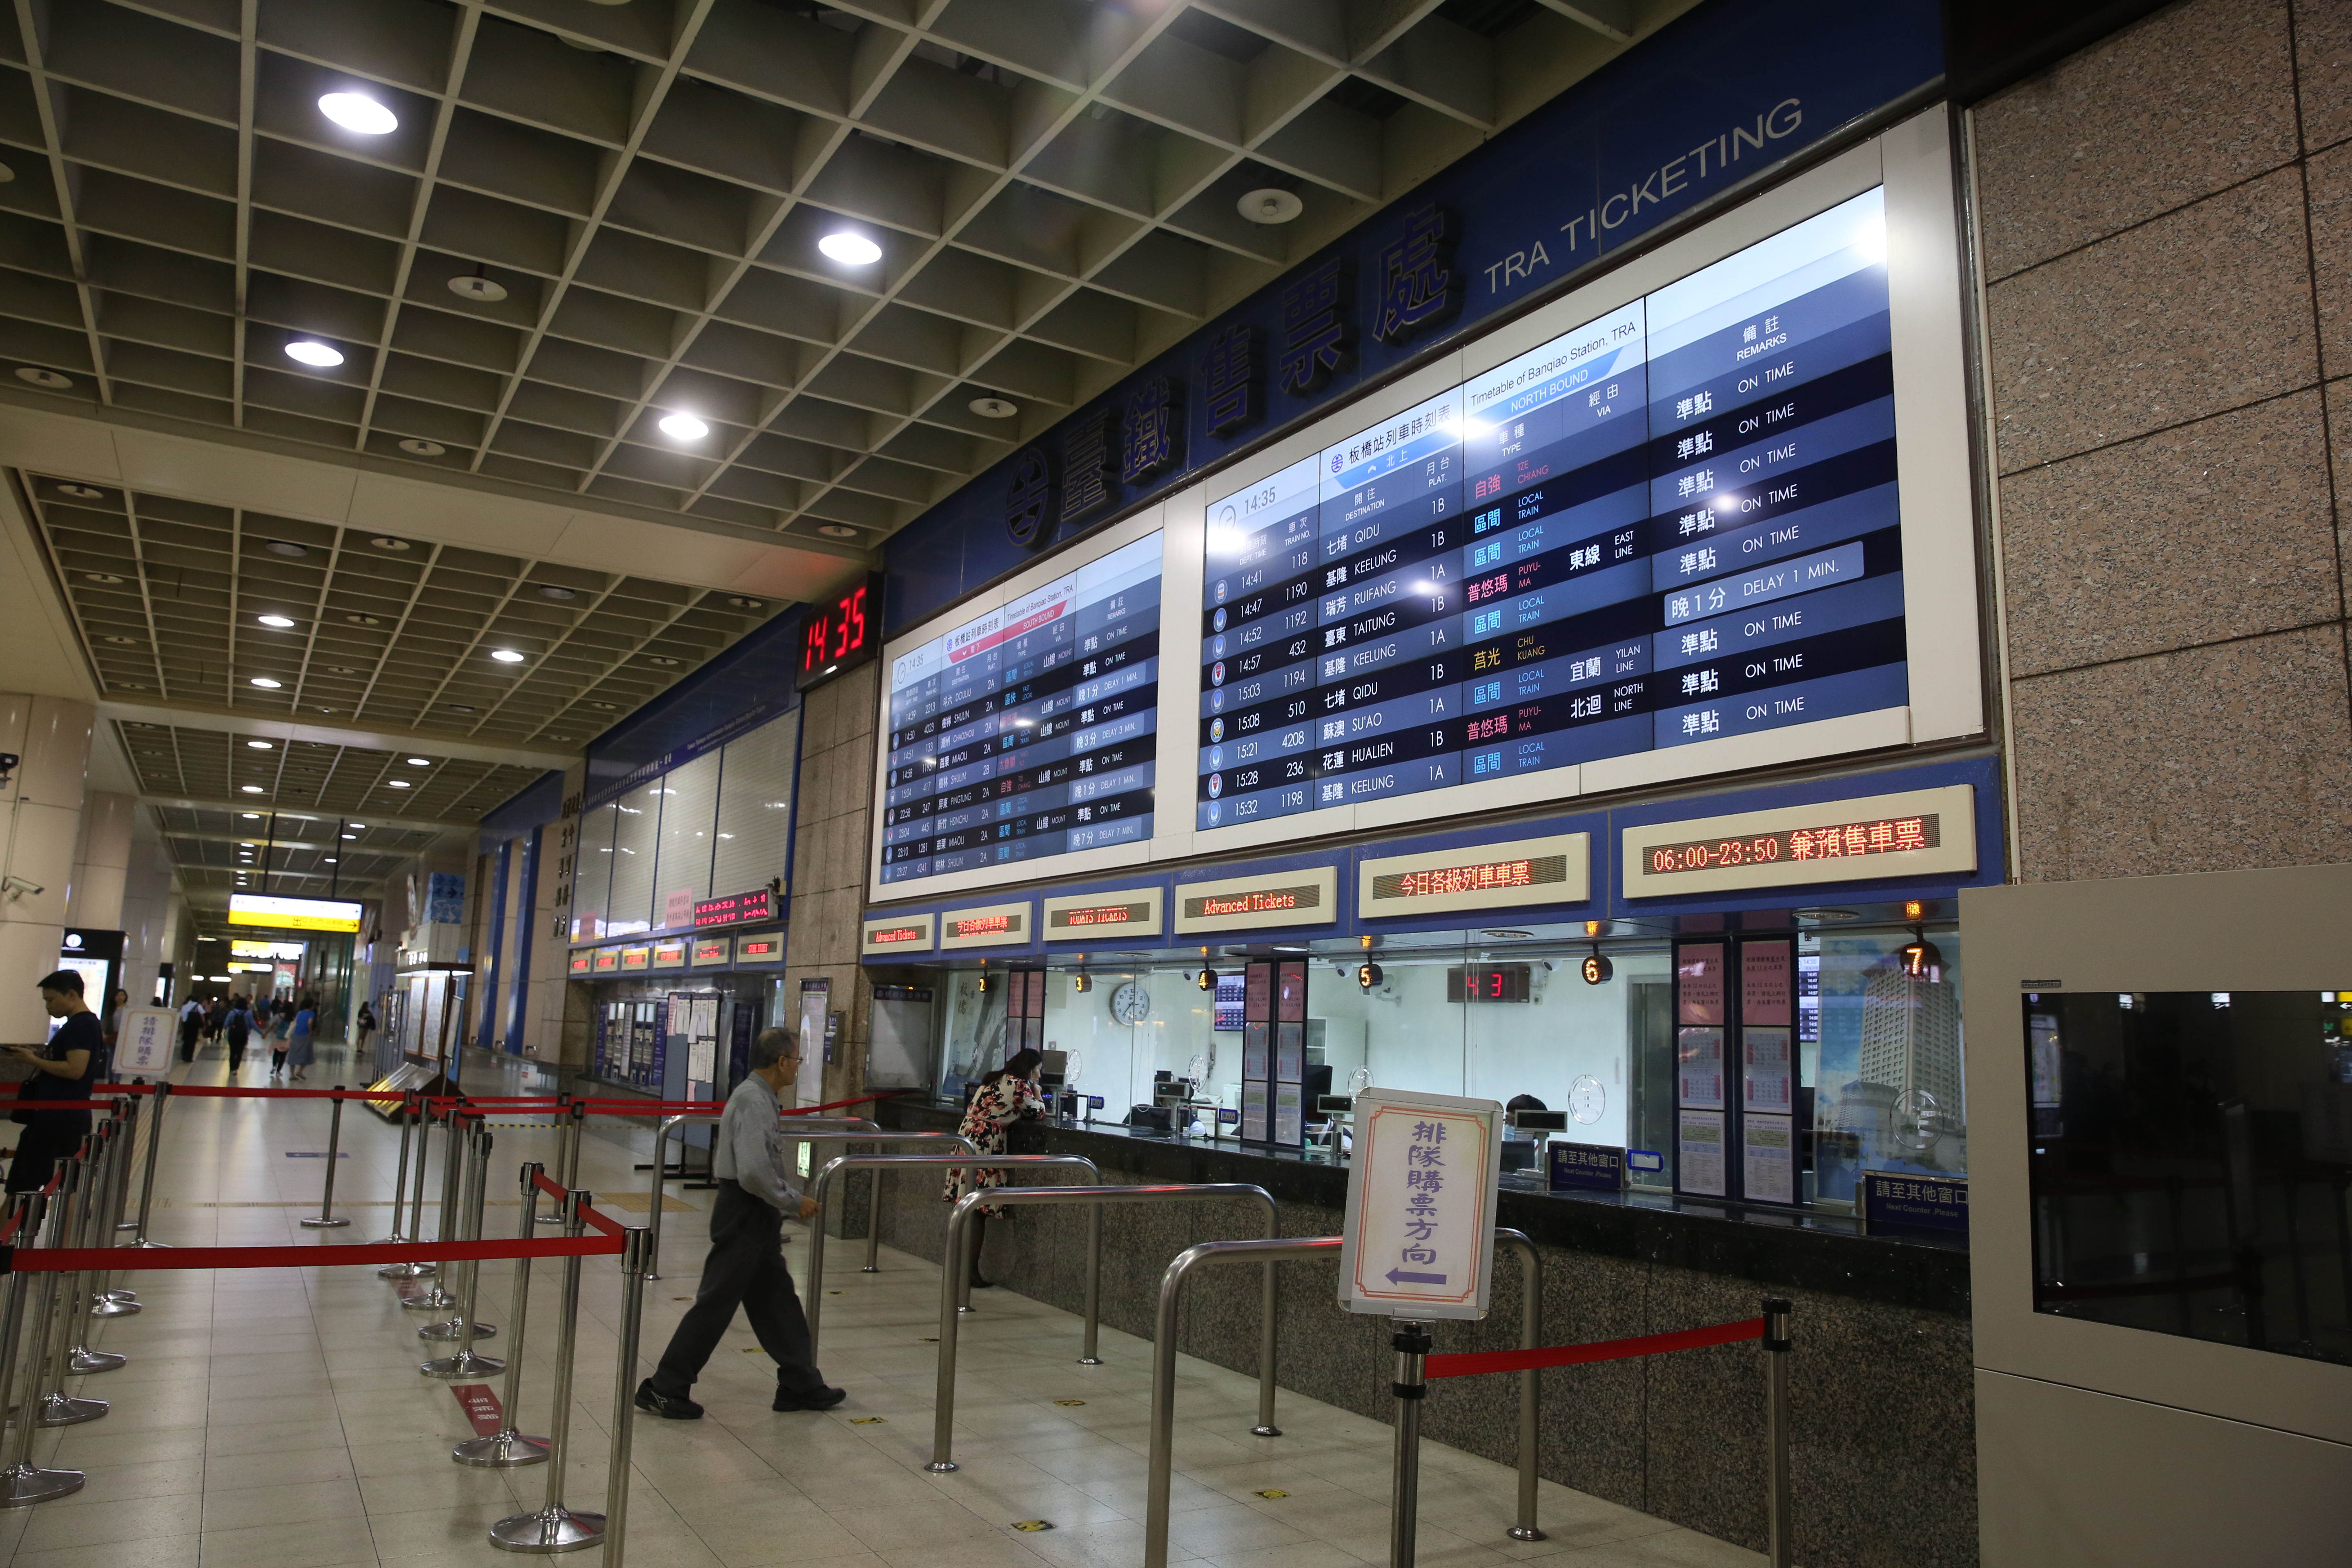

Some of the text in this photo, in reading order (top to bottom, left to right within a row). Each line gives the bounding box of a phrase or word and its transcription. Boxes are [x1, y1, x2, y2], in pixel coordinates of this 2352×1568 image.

[1484, 98, 1802, 294] TRA TICKETING
[1737, 333, 1787, 361] REMARKS
[1471, 322, 1636, 406] Timetable of Banqiao Station, TRA
[1511, 369, 1588, 412] NORTH BOUND
[1676, 361, 1794, 420] 準點 ON TIME
[1597, 405, 1611, 417] VIA
[1349, 404, 1450, 464] 板橋站列車時刻表
[1502, 442, 1521, 457] TYPE
[1518, 460, 1528, 471] TZE
[1518, 465, 1549, 483] CHIANG
[1429, 474, 1447, 487] PLAT.
[1476, 474, 1501, 498] 自強
[1245, 486, 1276, 514] 14:35
[1432, 497, 1445, 514] 1B
[1345, 499, 1385, 521] DESTINATION
[1285, 530, 1310, 546] TRAIN NO.
[1326, 523, 1379, 555] 七堵 QIDU
[1615, 531, 1634, 545] EAST
[1240, 548, 1266, 566] DEPT. TIME
[1292, 552, 1307, 568] 118
[1570, 544, 1600, 571] 東線
[1615, 545, 1633, 559] LINE
[1519, 562, 1541, 575] PUYU-
[1242, 570, 1262, 589] 14:41
[1468, 574, 1507, 602] 普悠瑪
[1519, 578, 1531, 588] MA
[1064, 585, 1073, 595] TRA
[1672, 559, 1839, 619] 晚1分 DELAY 1 MIN.
[1432, 596, 1444, 612] 1B
[1023, 610, 1054, 630] SOUTH BOUND
[1107, 608, 1126, 620] REMARKS
[1325, 612, 1395, 648] 臺東 TAITUNG
[1084, 626, 1127, 652] 準點 ON TIME
[1518, 636, 1534, 647] CHU
[1290, 640, 1306, 656] 432
[1517, 646, 1545, 660] KUANG
[1615, 645, 1640, 659] YILAN
[909, 655, 924, 671] 14:35
[1239, 654, 1261, 673] 14:57
[1474, 647, 1500, 670] 莒光
[1616, 660, 1634, 673] LINE
[1431, 664, 1443, 680] 1B
[1519, 669, 1544, 683] LOCAL
[1570, 657, 1601, 682] 宜蘭
[988, 679, 995, 690] 2A
[1474, 682, 1500, 704] 區間
[1519, 683, 1539, 695] TRAIN
[1614, 683, 1643, 697] NORTH
[943, 688, 971, 707] 斗六 DOULIU
[1324, 682, 1378, 708] 七堵 QIDU
[1288, 701, 1305, 717] 510
[1430, 697, 1444, 714] 1A
[1570, 694, 1601, 719] 北迴
[1614, 699, 1632, 712] LINE
[906, 710, 916, 722] 14:39
[942, 710, 969, 729] 樹林 SHULIN
[1238, 713, 1260, 731] 15:08
[1682, 697, 1804, 736] 準點 ON TIME
[1102, 729, 1117, 739] DELAY
[1119, 726, 1123, 734] 3
[1125, 722, 1136, 732] MIN.
[1323, 713, 1382, 740] 蘇澳 SU'AO
[1468, 715, 1507, 741] 普悠瑪
[1282, 731, 1304, 748] 4208
[1430, 731, 1443, 747] 1B
[1237, 742, 1258, 759] 15:21
[1323, 742, 1393, 771] 花蓮 HUALIEN
[940, 751, 967, 769] 苗栗 MIAOLI
[1474, 752, 1500, 774] 區間
[1287, 761, 1303, 777] 236
[1429, 765, 1444, 781] 1A
[1001, 780, 1012, 793] 自強
[1236, 771, 1258, 787] 15:28
[1322, 775, 1394, 802] 基隆 KEELUNG
[951, 793, 971, 805] PINGTUNG
[1281, 791, 1303, 807] 1198
[1236, 800, 1258, 816] 15:32
[950, 815, 968, 826] HSINCHU
[1654, 818, 1924, 871] 06:00-23:50 兼預售車票
[1401, 860, 1529, 897] 今日各級列車車票
[1204, 893, 1294, 915] Advanced Tickets
[875, 929, 916, 942] Advanced Tickets
[1907, 948, 1922, 975] 7
[1361, 968, 1370, 986] 5
[1586, 960, 1597, 981] 6
[980, 979, 985, 991] 2
[1076, 976, 1082, 990] 3
[1199, 973, 1207, 988] 4
[1558, 1149, 1618, 1168] 請至其他窗口
[1402, 1120, 1447, 1265] 排隊購票方向
[1876, 1181, 1968, 1205] 請至其他窗口
[1903, 1205, 1930, 1214] Counter
